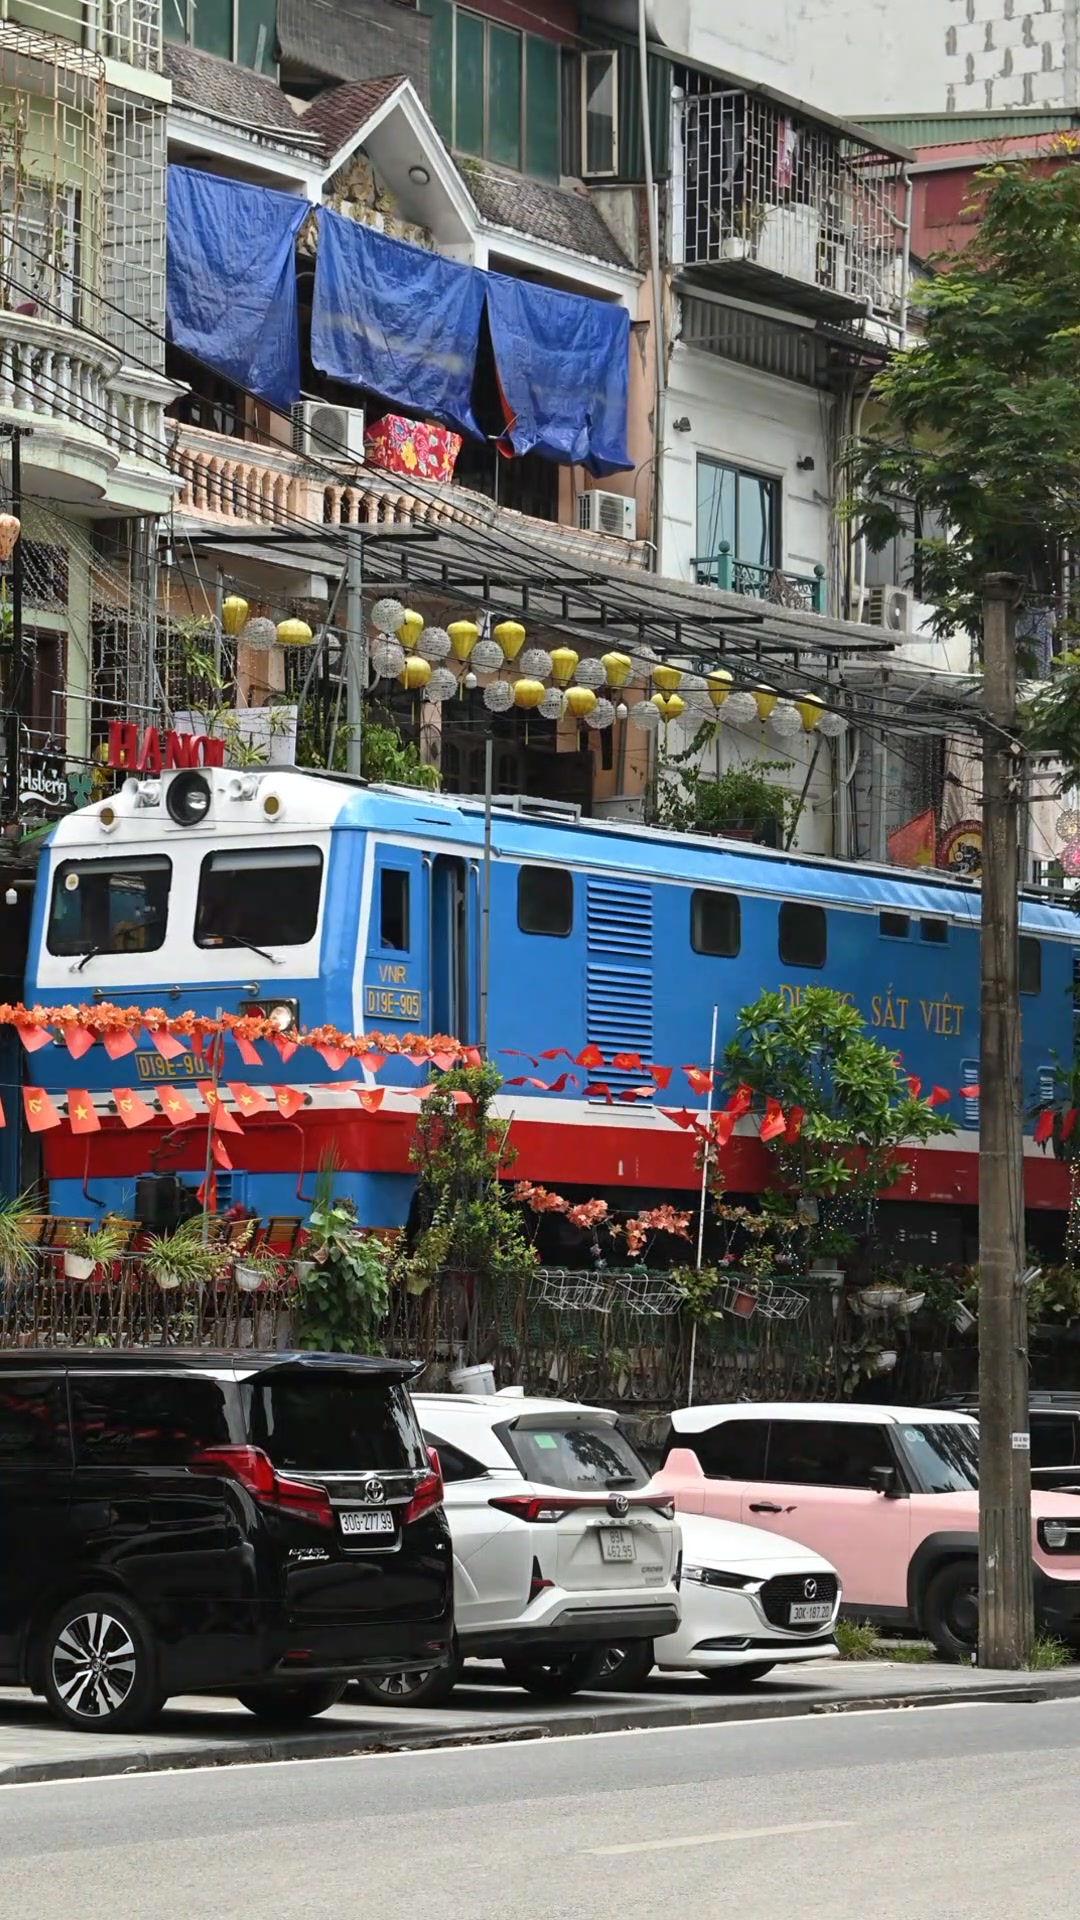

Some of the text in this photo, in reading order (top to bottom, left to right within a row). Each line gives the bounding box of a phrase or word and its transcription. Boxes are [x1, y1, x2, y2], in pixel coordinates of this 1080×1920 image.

[107, 720, 225, 774] HANOI
[3, 763, 67, 801] rlsberg
[378, 965, 406, 984] VNR
[369, 991, 419, 1016] D19E-905
[871, 983, 908, 1030] SẮT
[920, 992, 965, 1040] VIỆT
[139, 1055, 213, 1077] D19E-90
[342, 1513, 393, 1531] 30G-277.99
